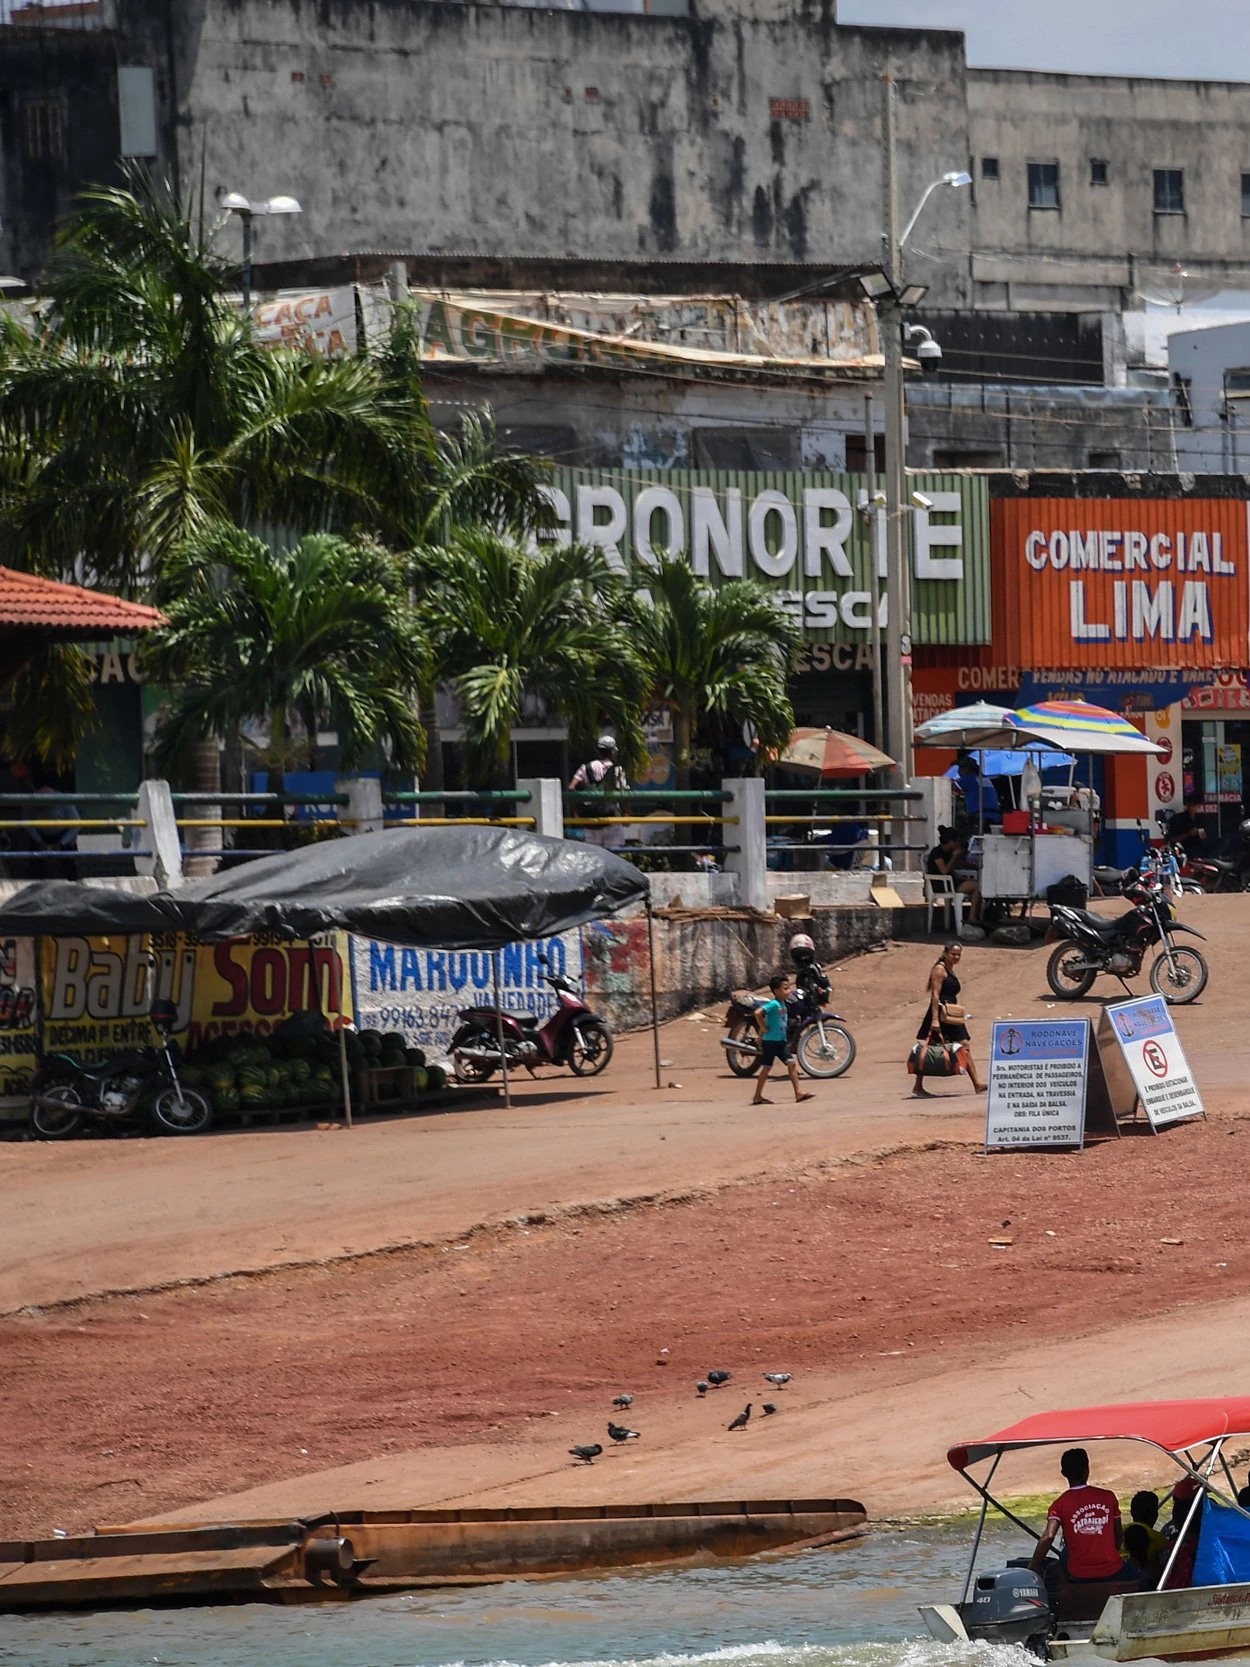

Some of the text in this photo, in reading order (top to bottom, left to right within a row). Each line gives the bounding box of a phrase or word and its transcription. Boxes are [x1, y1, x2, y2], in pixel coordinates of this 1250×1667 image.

[1026, 530, 1235, 575] COMERCIAL
[1071, 580, 1213, 641] LIMA
[52, 935, 344, 1034] Baby Som
[1008, 1063, 1043, 1071] MOTORISTAS
[1049, 1062, 1076, 1070] PROIBIDO
[1008, 1081, 1034, 1089] INTERIOR
[1035, 1080, 1047, 1088] DOS
[1045, 1090, 1076, 1098] TRAVESSIA
[993, 1126, 1030, 1134] CAPITANIA
[1019, 1587, 1039, 1597] YAMAHA
